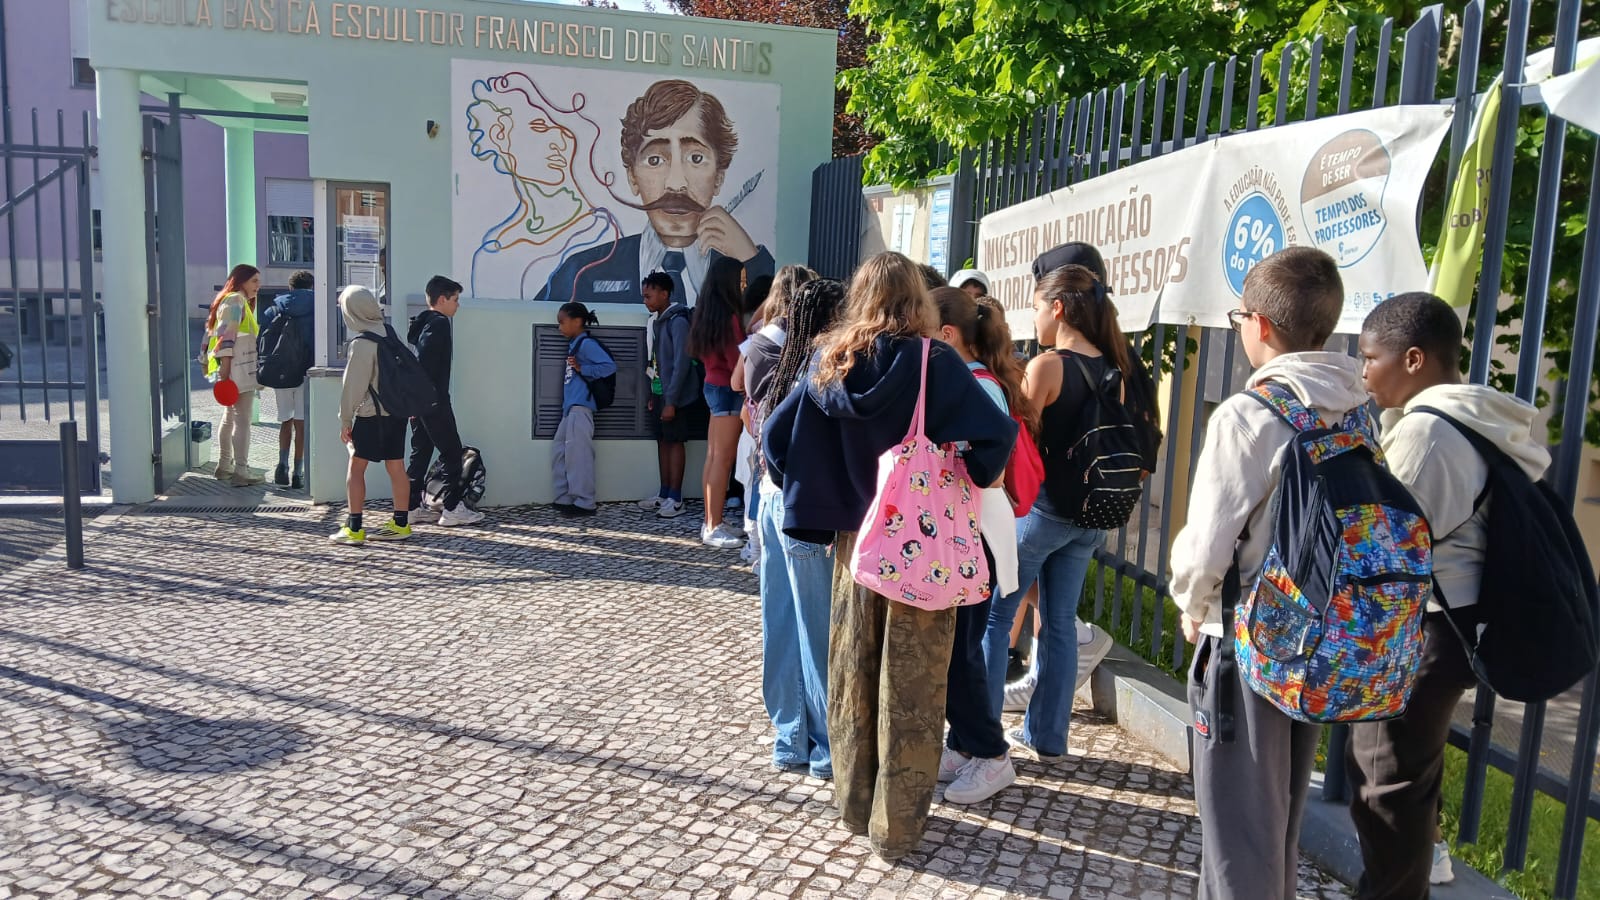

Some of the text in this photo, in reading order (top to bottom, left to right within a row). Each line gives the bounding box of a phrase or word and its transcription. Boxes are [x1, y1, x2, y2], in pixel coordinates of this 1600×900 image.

[331, 3, 465, 47] ESCULTOR
[474, 16, 614, 60] FRANCISCO
[624, 29, 673, 65] DOS
[682, 34, 773, 75] SANTOS
[1320, 146, 1362, 171] É TEMPO
[1322, 164, 1351, 188] DE SER
[1223, 198, 1233, 212] A
[1262, 172, 1278, 197] NÃO
[1274, 188, 1292, 226] PODE
[1315, 192, 1368, 225] TEMPO DOS
[984, 226, 1039, 273] INVESTIR
[1043, 216, 1062, 252] NA
[1066, 185, 1152, 253] EDUCAÇÃO
[1234, 215, 1275, 259] 6%
[1315, 209, 1382, 245] PROFESSORES
[1230, 251, 1246, 271] do
